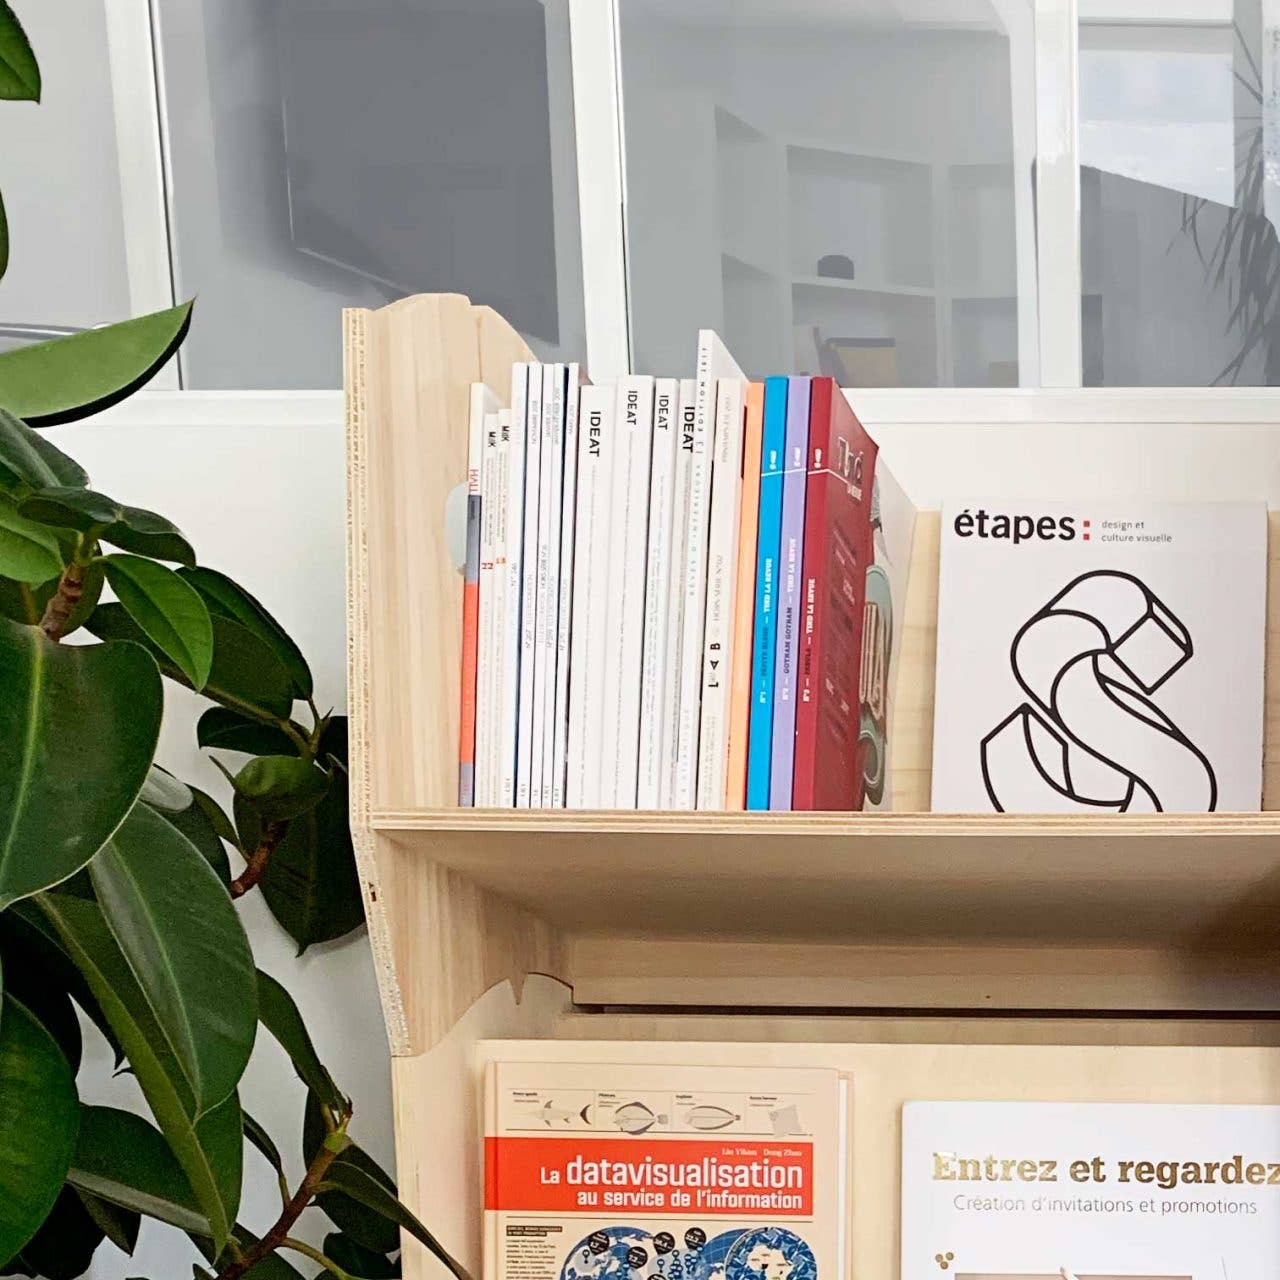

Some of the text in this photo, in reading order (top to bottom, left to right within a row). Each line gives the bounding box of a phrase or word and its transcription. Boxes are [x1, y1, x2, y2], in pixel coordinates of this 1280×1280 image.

[626, 390, 638, 426] IDEAT
[657, 395, 669, 431] IDEAT
[588, 411, 601, 458] IDEAT
[682, 405, 696, 454] IDEAT
[1101, 520, 1145, 532] design et
[1101, 533, 1173, 543] culture visuelle
[540, 1155, 803, 1189] La datavisualisation
[932, 1151, 1057, 1182] Entrez
[1069, 1155, 1106, 1183] et
[577, 1189, 803, 1210] au service de l'information
[953, 1194, 1257, 1217] Création d'invitations et promotions
